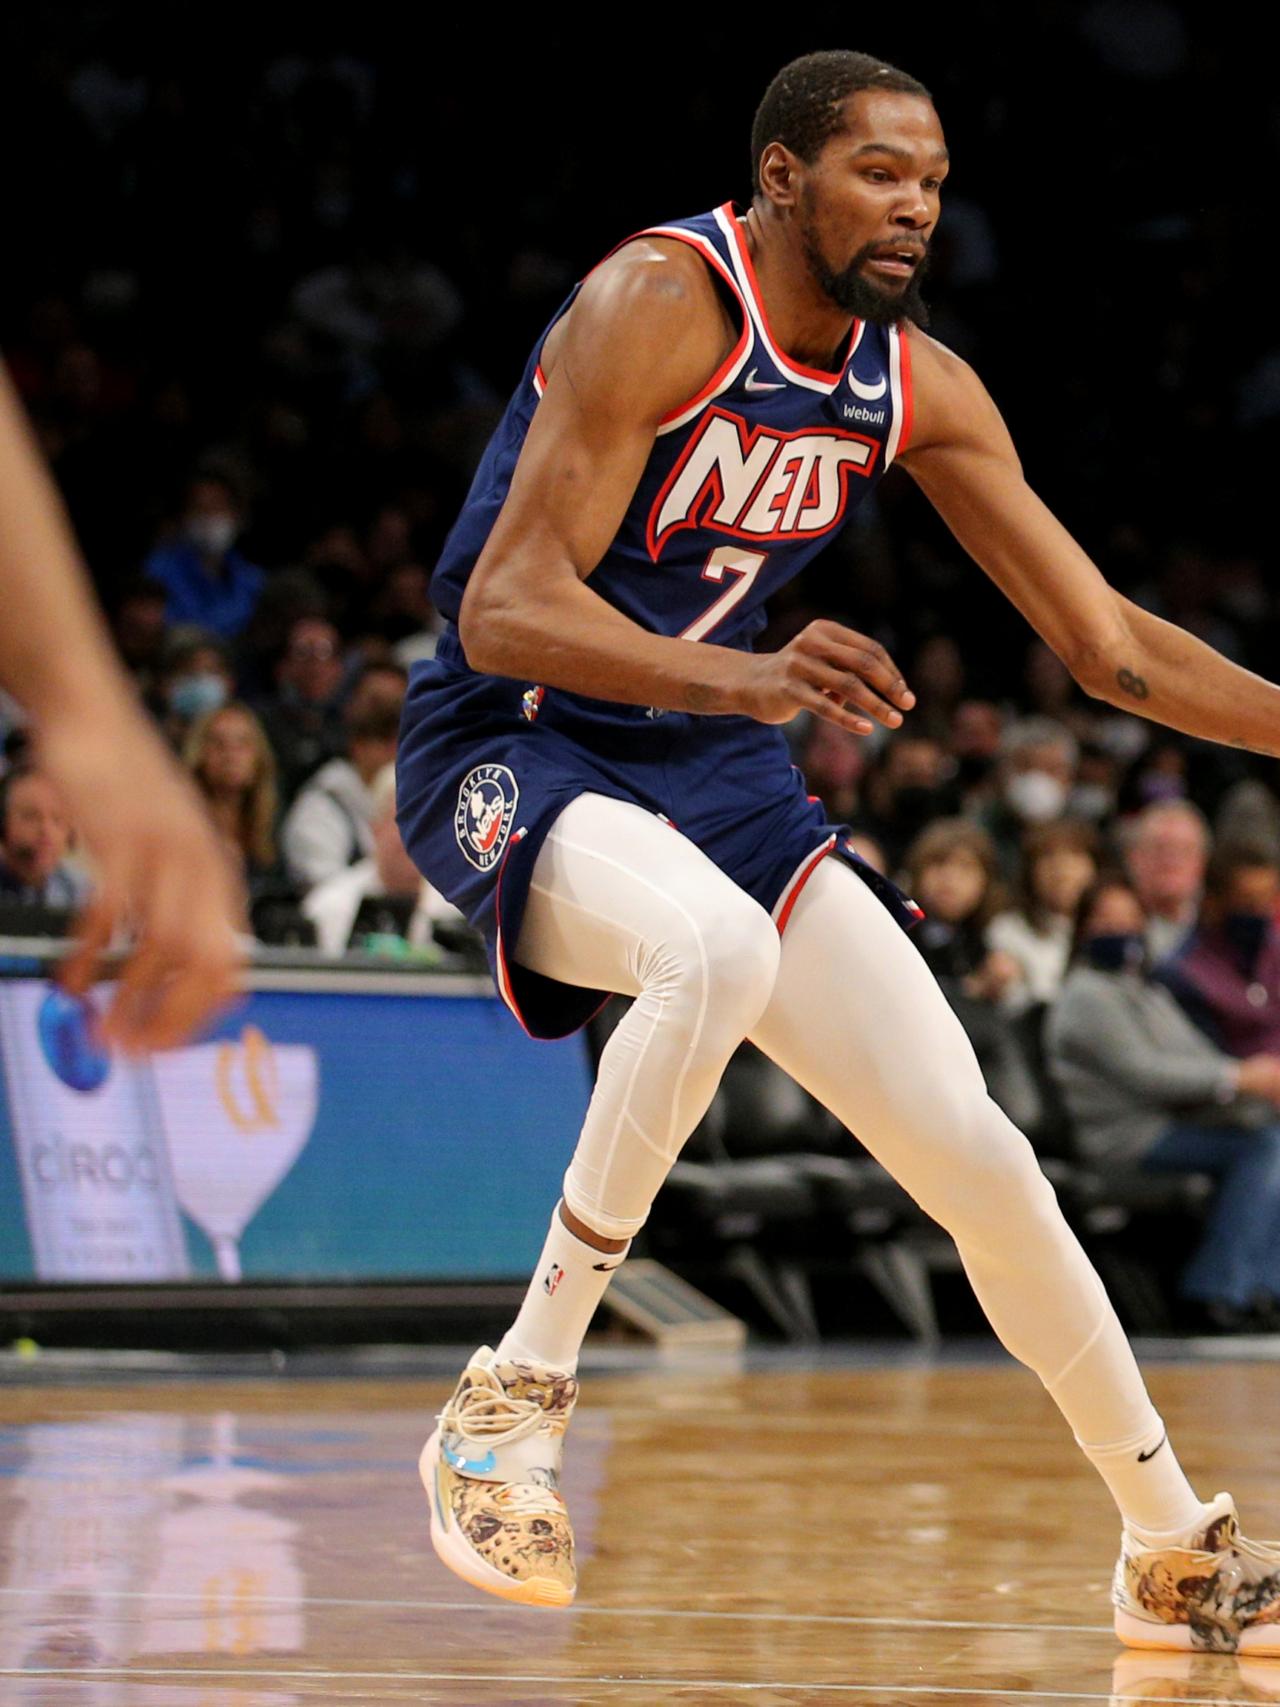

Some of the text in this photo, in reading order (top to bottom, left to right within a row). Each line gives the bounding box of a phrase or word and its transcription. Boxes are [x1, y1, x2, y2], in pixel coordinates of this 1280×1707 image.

[842, 403, 886, 425] Webull
[648, 405, 878, 556] NETS
[678, 545, 768, 642] 7
[458, 767, 502, 839] BROOKLYN
